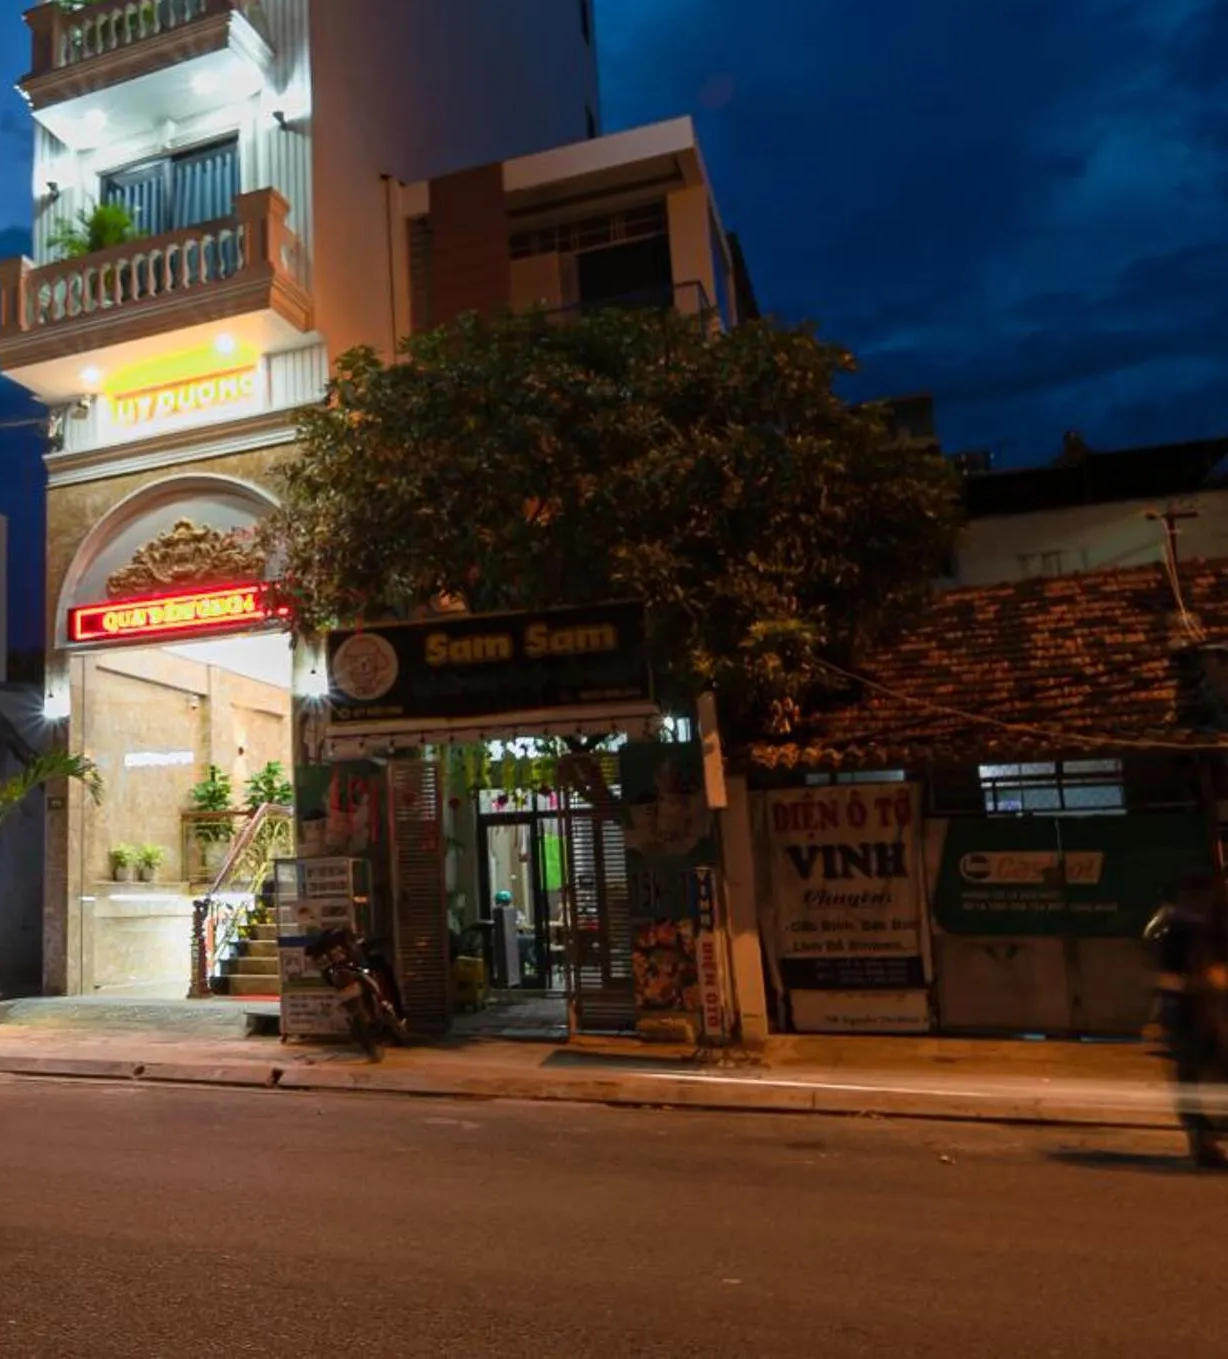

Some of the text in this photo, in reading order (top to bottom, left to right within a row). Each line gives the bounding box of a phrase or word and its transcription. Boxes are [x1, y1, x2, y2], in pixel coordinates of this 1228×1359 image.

[425, 620, 618, 667] Sam Sam
[784, 842, 909, 880] VINH
